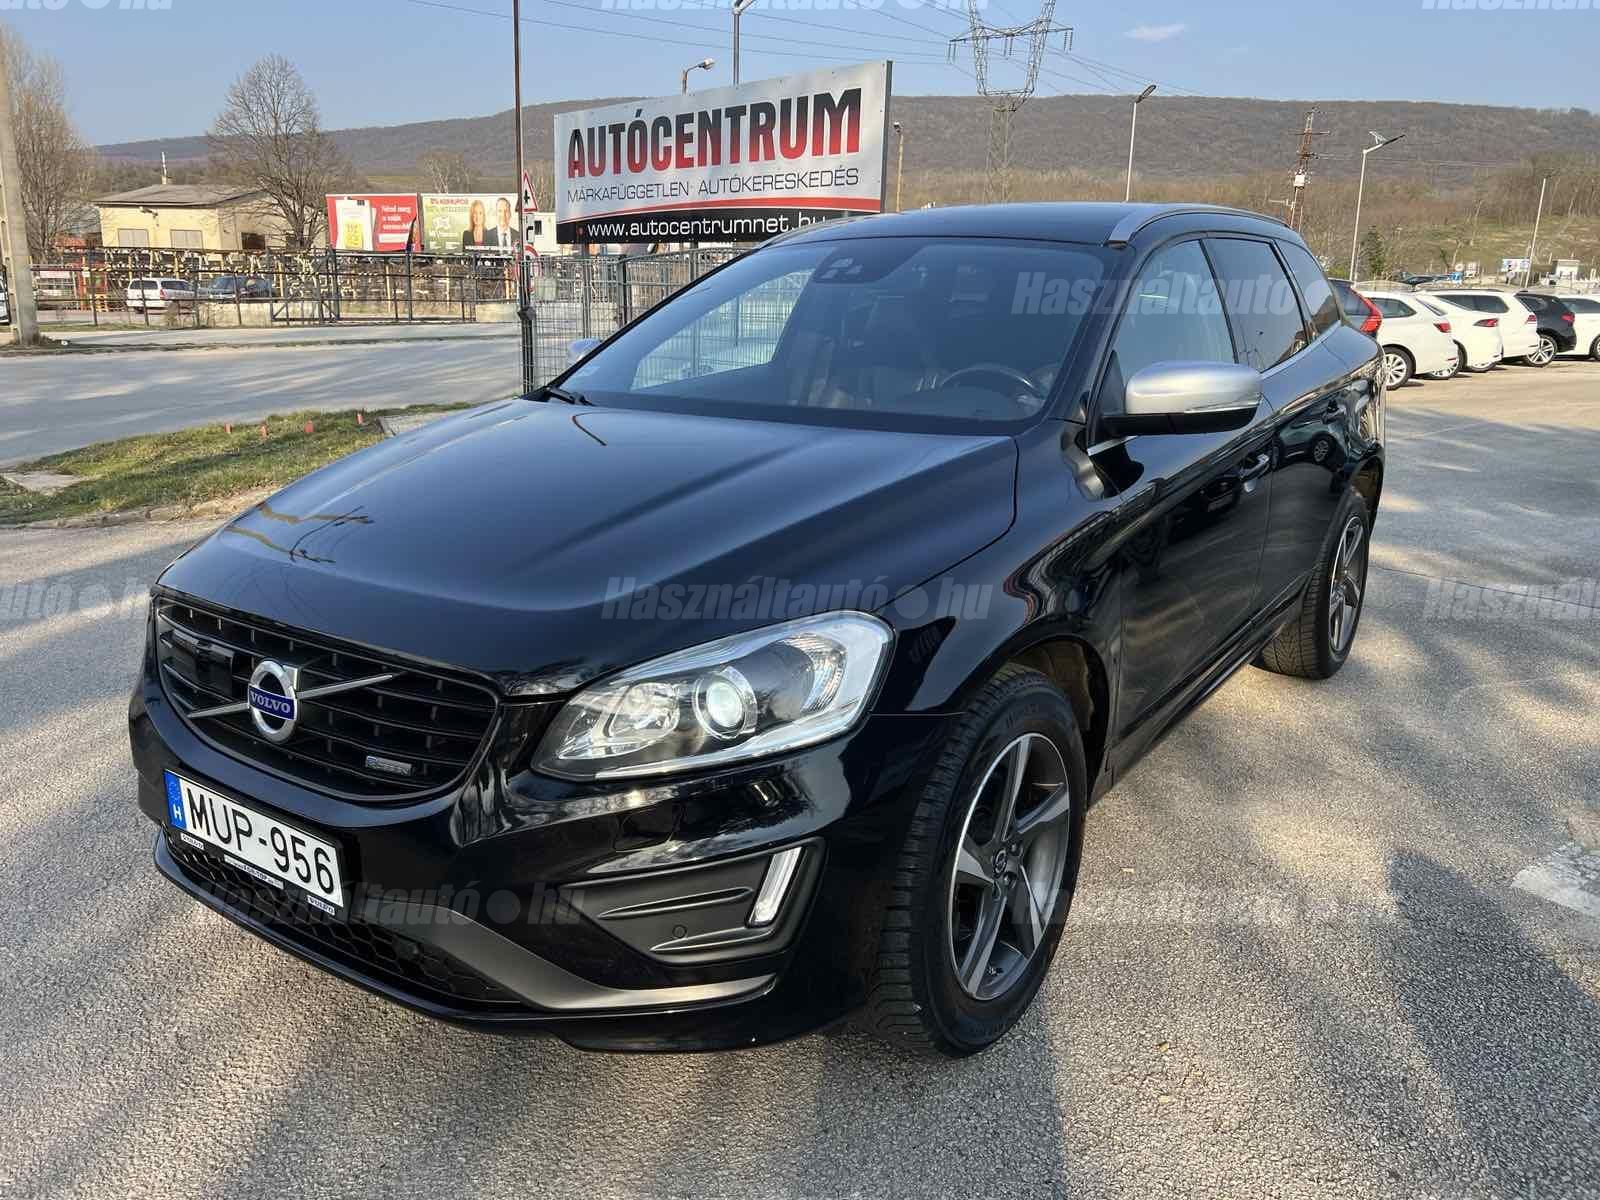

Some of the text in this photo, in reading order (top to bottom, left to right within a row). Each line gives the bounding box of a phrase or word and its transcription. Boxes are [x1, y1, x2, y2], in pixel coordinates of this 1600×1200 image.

[568, 88, 862, 179] AUTÓCENTRUM
[567, 164, 859, 203] MÁRKAFÜGGETLEN AUTÓKERESKEDÉS
[250, 690, 291, 714] VOLVO
[173, 804, 182, 821] H
[186, 787, 334, 895] MUP-956
